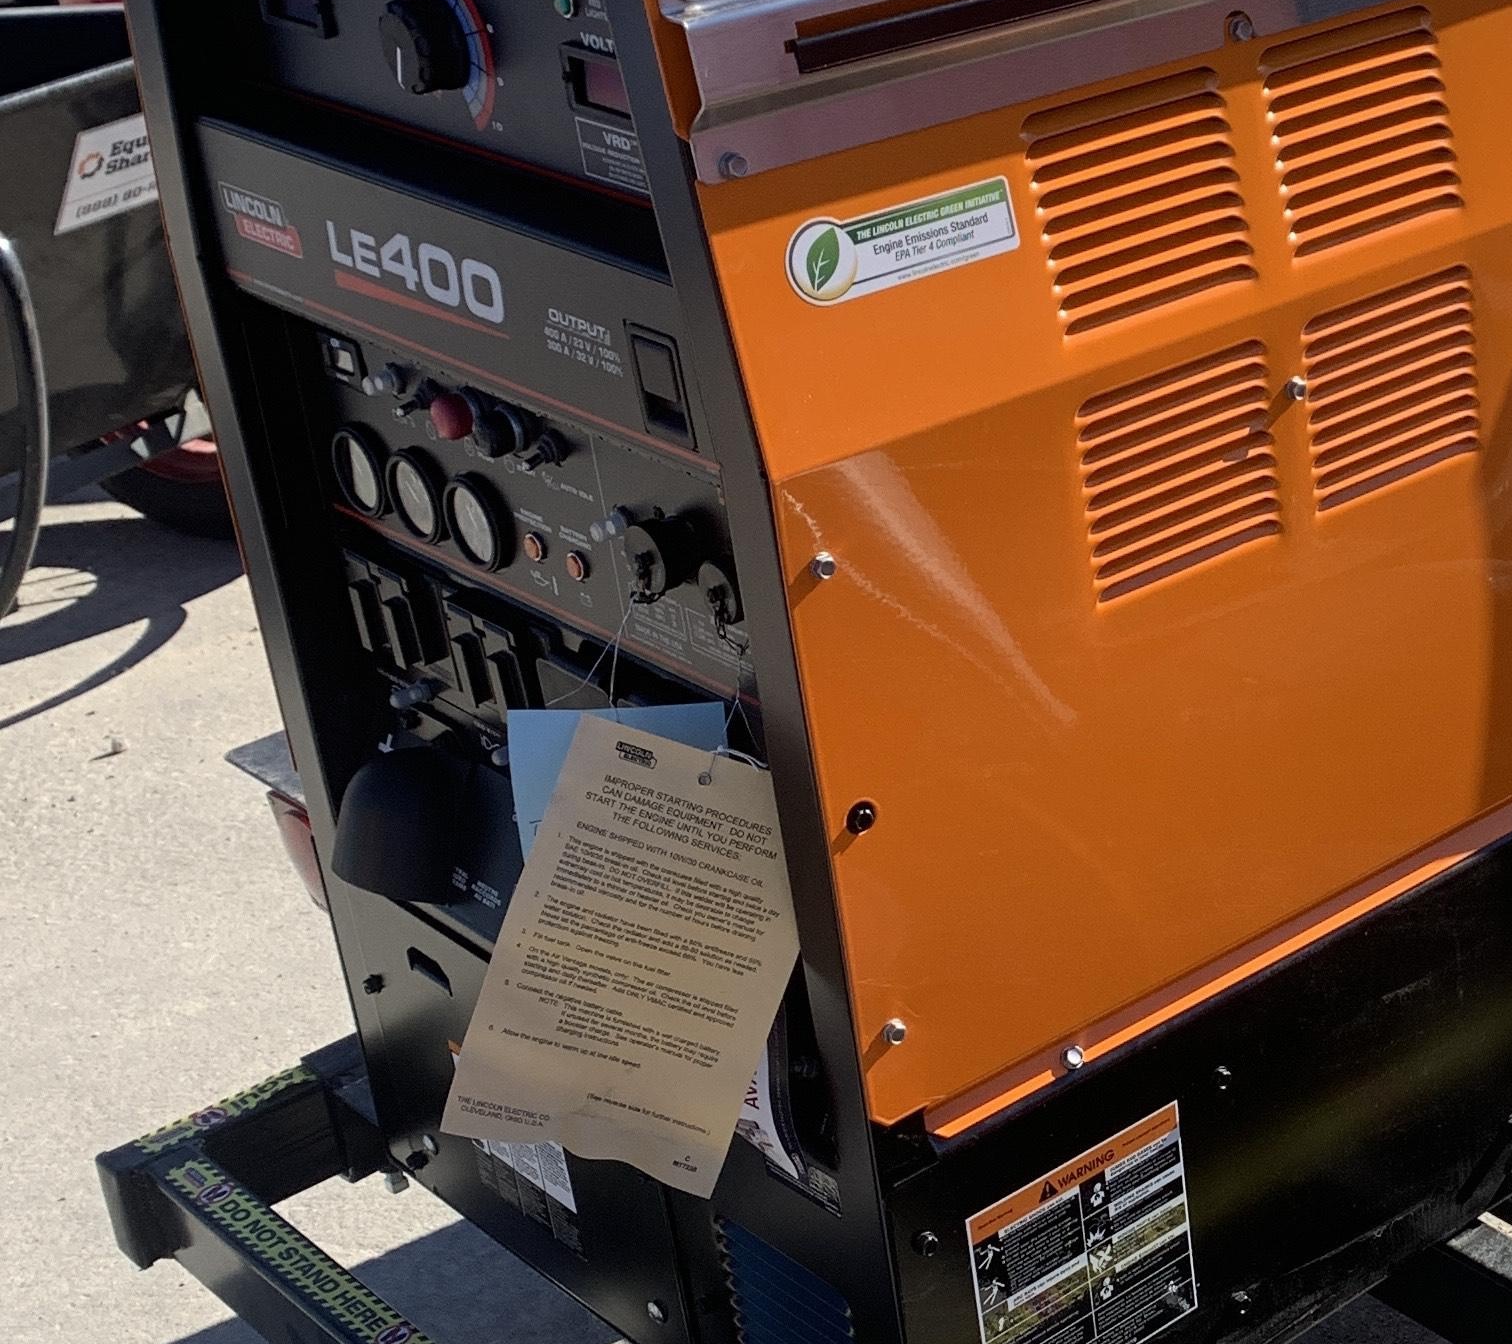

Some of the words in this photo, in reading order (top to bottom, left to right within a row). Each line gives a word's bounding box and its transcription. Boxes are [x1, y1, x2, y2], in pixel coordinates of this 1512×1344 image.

[222, 188, 283, 226] LINCOLN
[857, 230, 872, 241] THE
[872, 217, 903, 237] LINCOLN
[905, 207, 939, 228] ELECTRIC
[940, 201, 963, 219] GREEN
[241, 217, 296, 252] ELECTRIC
[873, 239, 904, 256] Engine
[905, 226, 949, 245] Emissions
[949, 212, 988, 231] Standard
[895, 248, 910, 261] EPA
[911, 245, 927, 256] Tier
[928, 243, 934, 252] 4
[935, 230, 975, 250] Compliant
[326, 220, 505, 325] LE400
[616, 740, 653, 760] LINCOLN
[584, 790, 616, 808] START
[617, 802, 636, 814] THE
[637, 808, 674, 827] ENGINE
[676, 821, 704, 837] UNTIL
[705, 830, 727, 844] YOU
[723, 838, 777, 860] PERFORM
[601, 784, 623, 798] CAN
[623, 791, 665, 812] DAMAGE
[729, 826, 744, 838] DO
[745, 832, 768, 846] NOT
[603, 773, 654, 797] IMPROPER
[654, 790, 704, 814] STARTING
[704, 806, 773, 836] PROCEDURES
[611, 811, 631, 824] THE
[631, 818, 689, 844] FOLLOWING
[575, 820, 607, 837] ENGINE
[608, 831, 644, 849] SHIPPED
[644, 843, 668, 857] WITH
[697, 859, 750, 884] CRANKCASE
[456, 1095, 471, 1104] THE
[472, 1098, 503, 1112] LINCOLN
[503, 1105, 537, 1120] ELECTRIC
[1057, 1149, 1115, 1190] WARNING
[219, 1199, 249, 1223] DO
[244, 1222, 287, 1249] NOT
[278, 1246, 340, 1294] STAND
[333, 1290, 388, 1333] HERE
